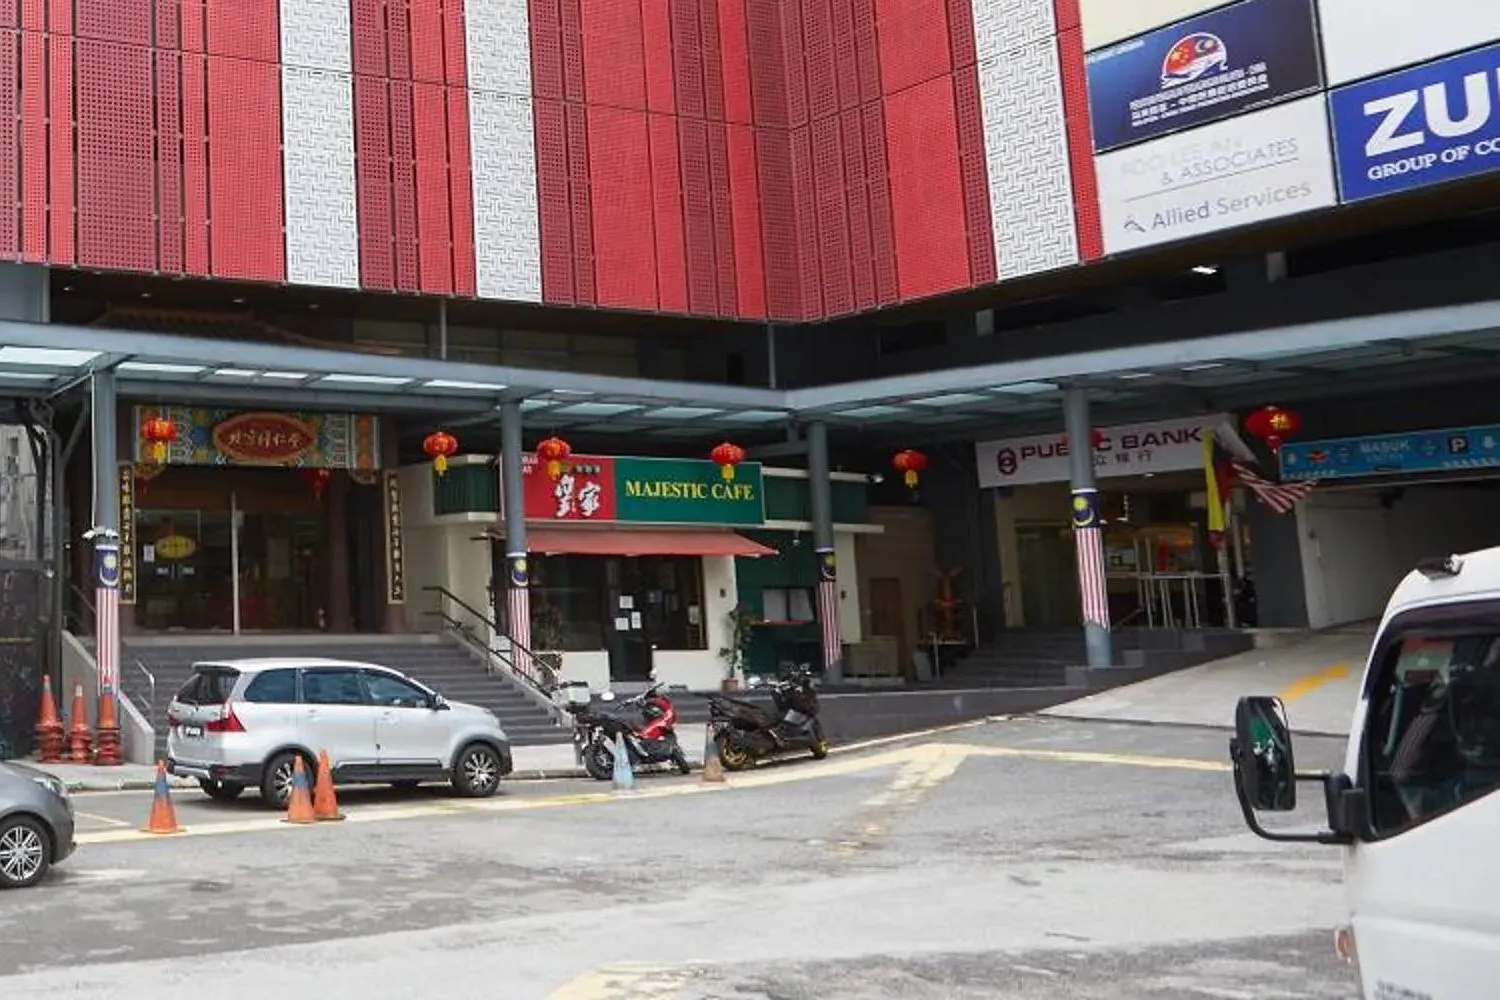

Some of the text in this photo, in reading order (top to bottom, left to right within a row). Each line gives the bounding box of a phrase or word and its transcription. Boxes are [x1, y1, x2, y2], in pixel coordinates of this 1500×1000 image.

[1363, 67, 1500, 158] ZU
[1181, 137, 1300, 180] ASSOCIATES
[1367, 153, 1438, 181] GROUP
[1440, 144, 1471, 163] OF
[1151, 181, 1313, 231] Allied Services
[1020, 427, 1203, 461] PUBC BANK
[625, 480, 754, 500] MAJESTIC CAFE
